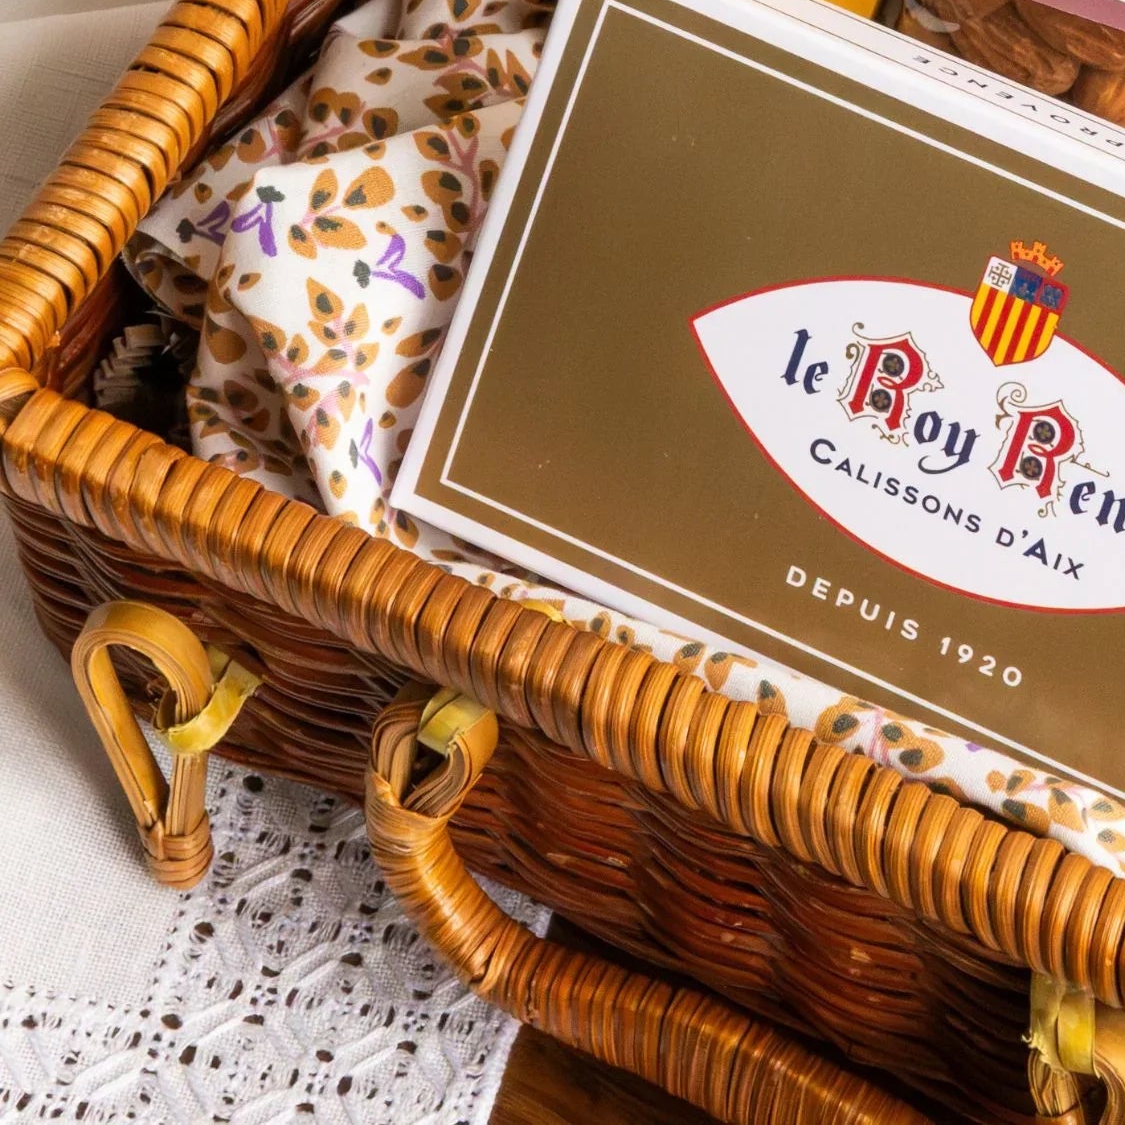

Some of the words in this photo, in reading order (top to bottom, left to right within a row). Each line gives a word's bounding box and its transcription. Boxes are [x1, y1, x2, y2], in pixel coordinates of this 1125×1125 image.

[780, 328, 829, 395] le
[837, 324, 980, 475] Roy
[808, 437, 982, 534] CALISSONS
[995, 526, 1085, 581] D'AIX
[785, 564, 920, 641] DEPUIS
[938, 636, 1024, 689] 1920
